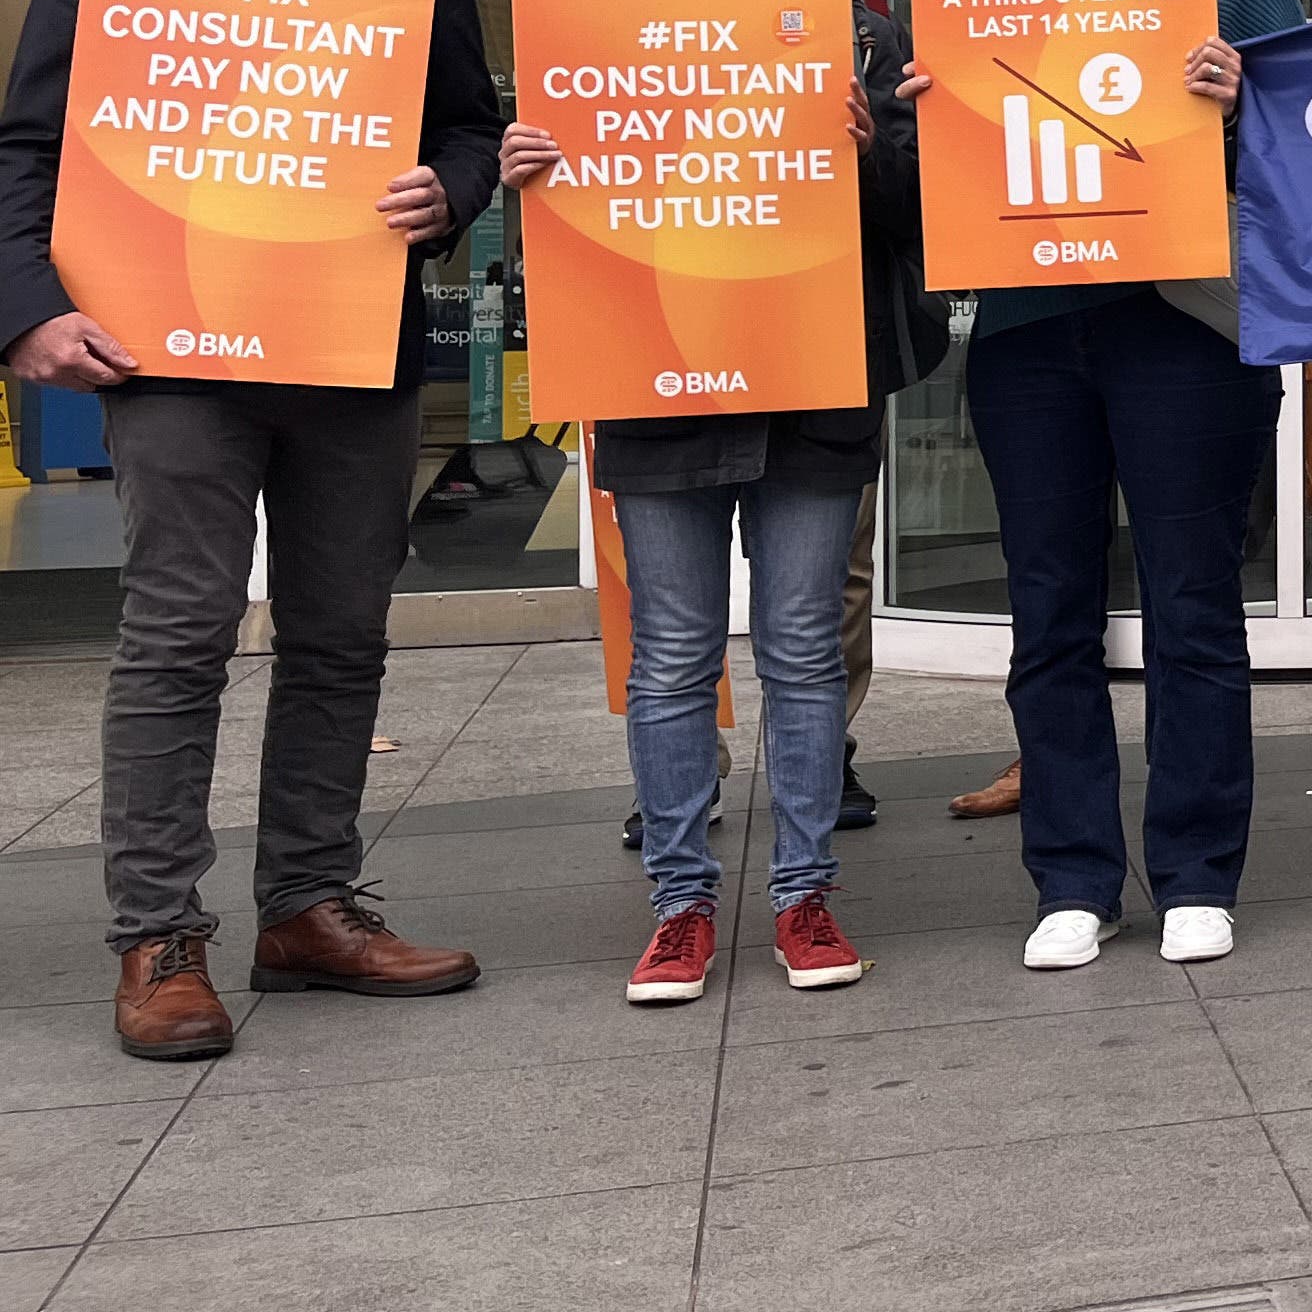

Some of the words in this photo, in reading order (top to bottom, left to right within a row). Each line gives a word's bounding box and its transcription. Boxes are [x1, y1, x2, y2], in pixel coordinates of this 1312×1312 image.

[103, 5, 404, 58] CONSULTANT
[639, 21, 738, 52] #FIX
[968, 15, 1033, 37] LAST
[1040, 14, 1069, 34] 14
[1075, 9, 1161, 32] YEARS
[148, 54, 229, 89] PAY
[240, 61, 348, 99] NOW
[544, 63, 831, 98] CONSULTANT
[1099, 66, 1123, 102] £
[90, 96, 189, 132] AND
[202, 104, 291, 140] FOR
[303, 111, 392, 147] THE
[597, 110, 672, 141] PAY
[685, 107, 784, 139] NOW
[148, 146, 327, 188] FUTURE
[547, 154, 642, 187] AND
[656, 152, 739, 184] FOR
[749, 150, 834, 181] THE
[610, 195, 780, 229] FUTURE
[1061, 240, 1118, 262] BMA
[423, 281, 496, 304] Hospit
[199, 333, 264, 358] BMA
[686, 371, 748, 393] BMA
